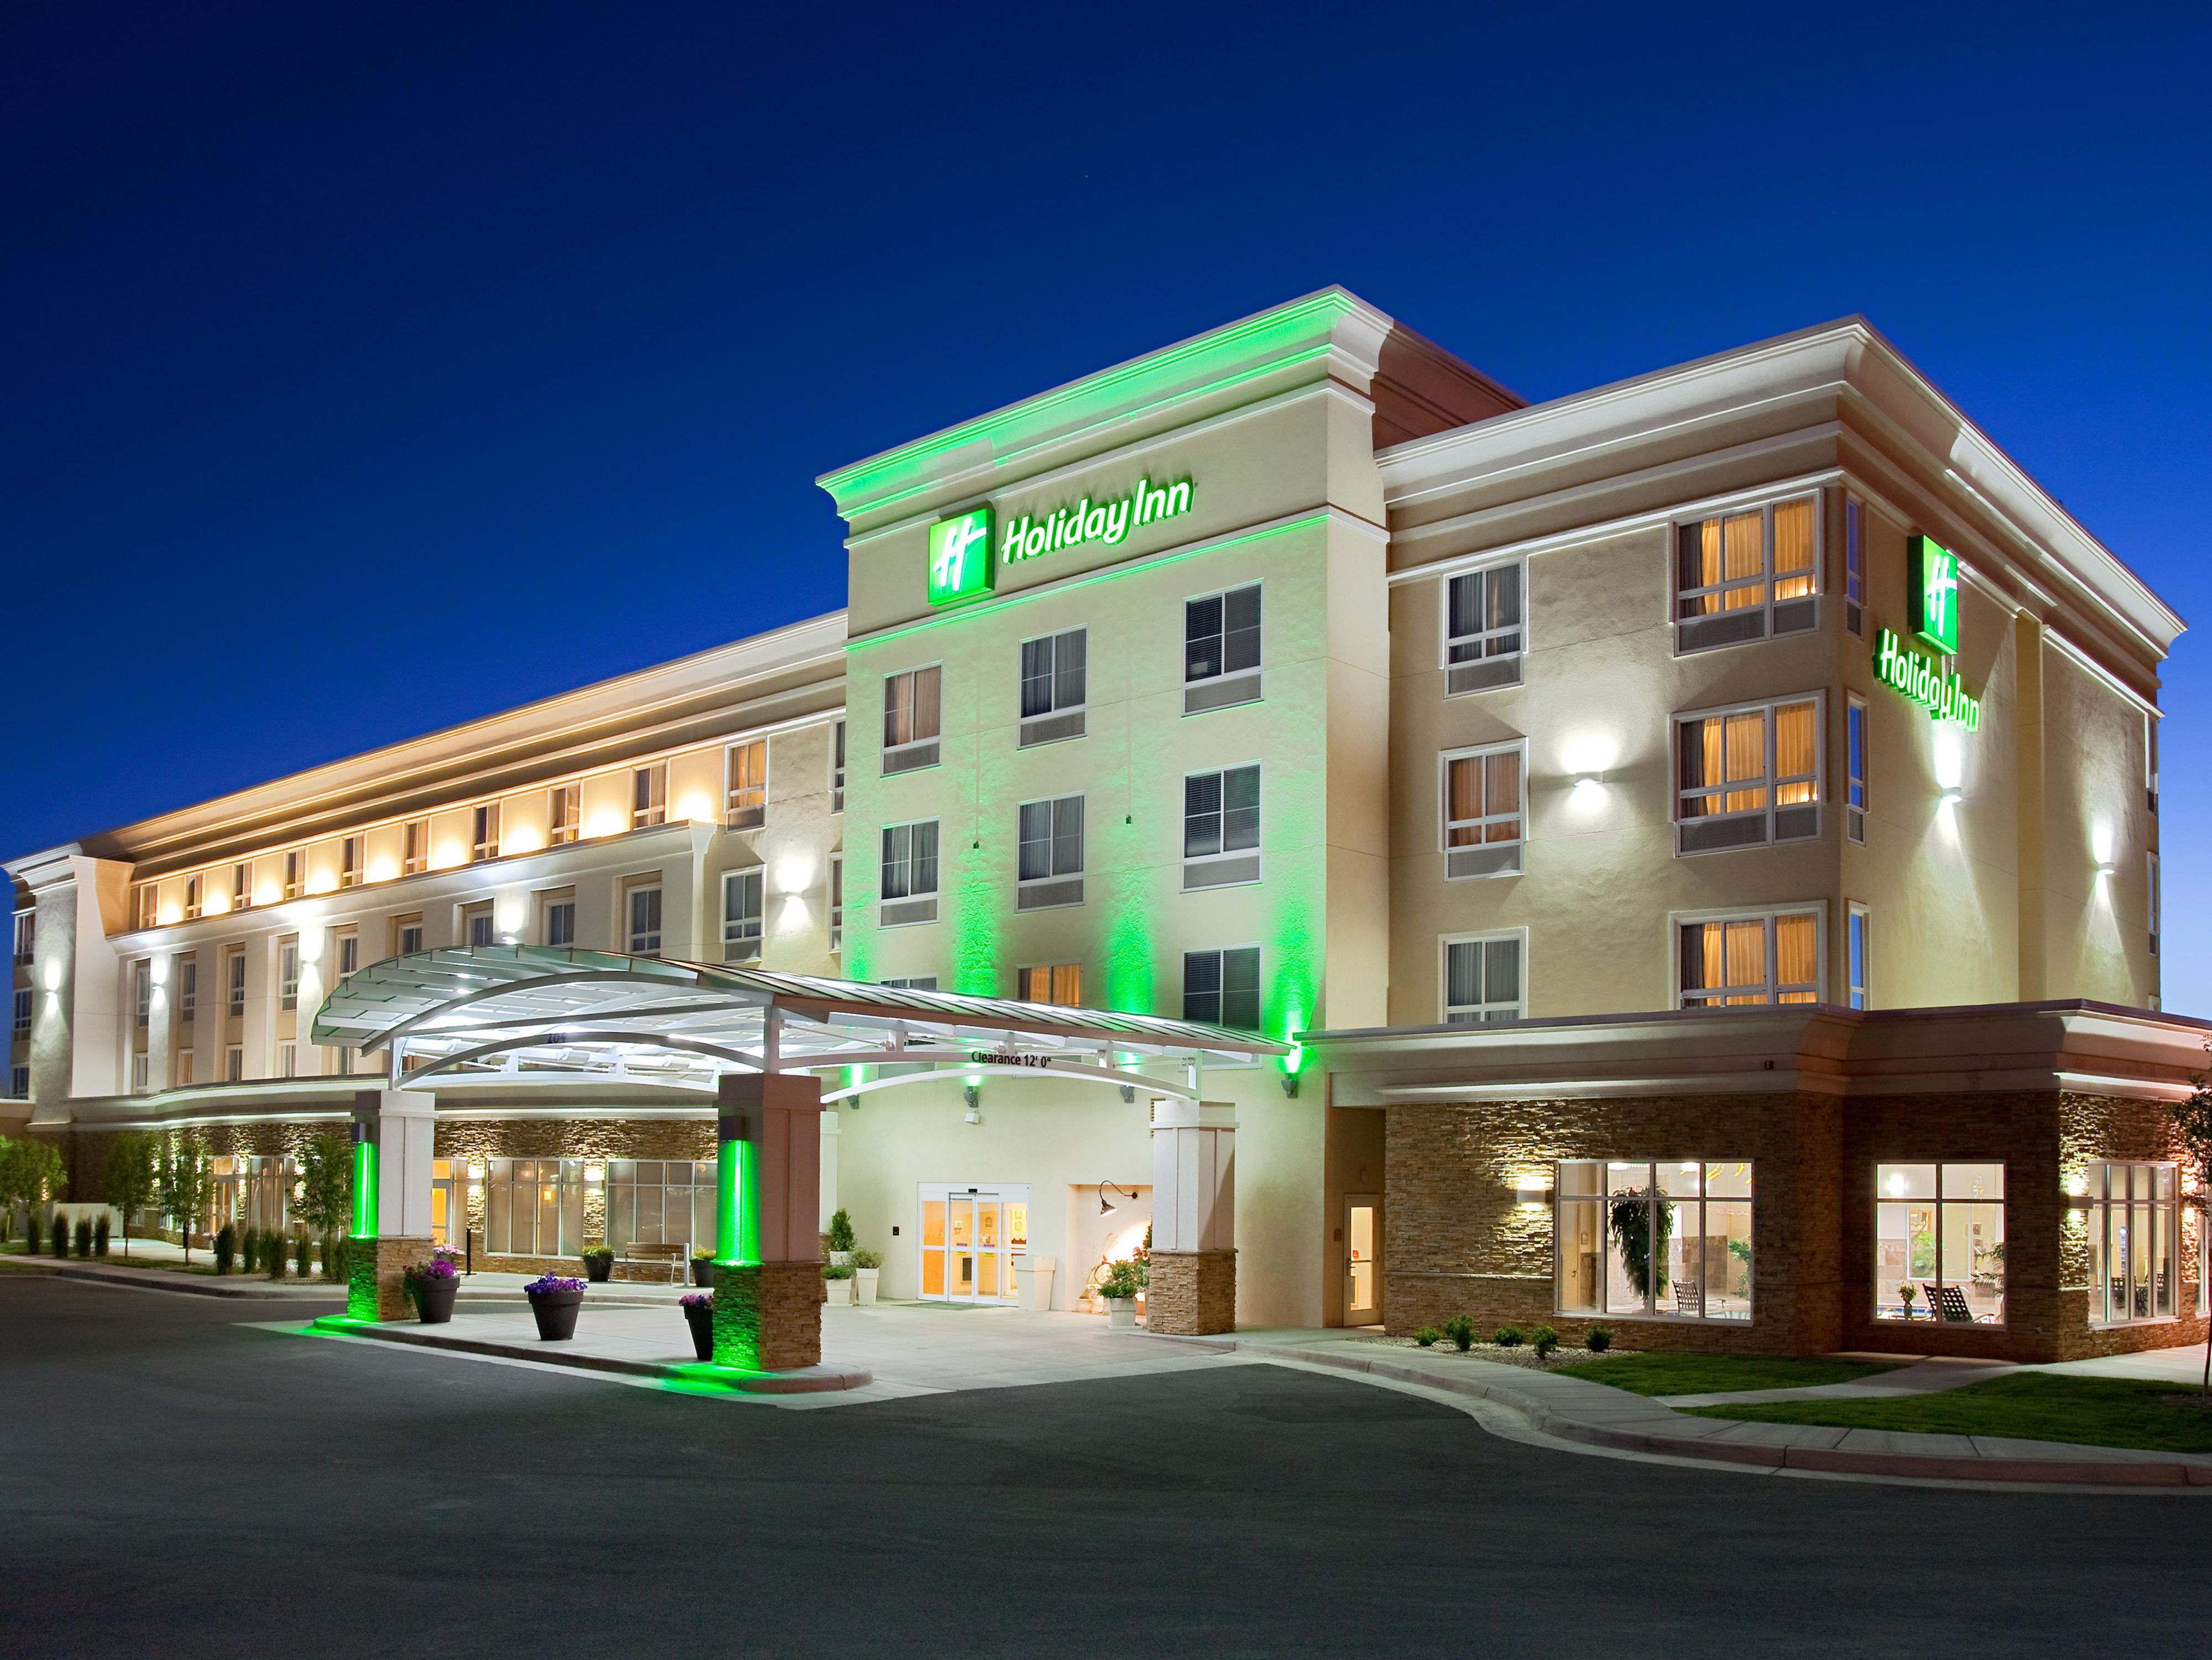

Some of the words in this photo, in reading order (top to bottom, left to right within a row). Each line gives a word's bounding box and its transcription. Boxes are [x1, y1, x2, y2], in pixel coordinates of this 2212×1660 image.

[1000, 498, 1131, 564] Holiday
[1133, 478, 1194, 526] Inn
[1875, 628, 1952, 725] Holiday
[1949, 673, 1980, 732] Inn
[972, 1051, 1021, 1065] Clearance
[1024, 1054, 1037, 1066] 12'
